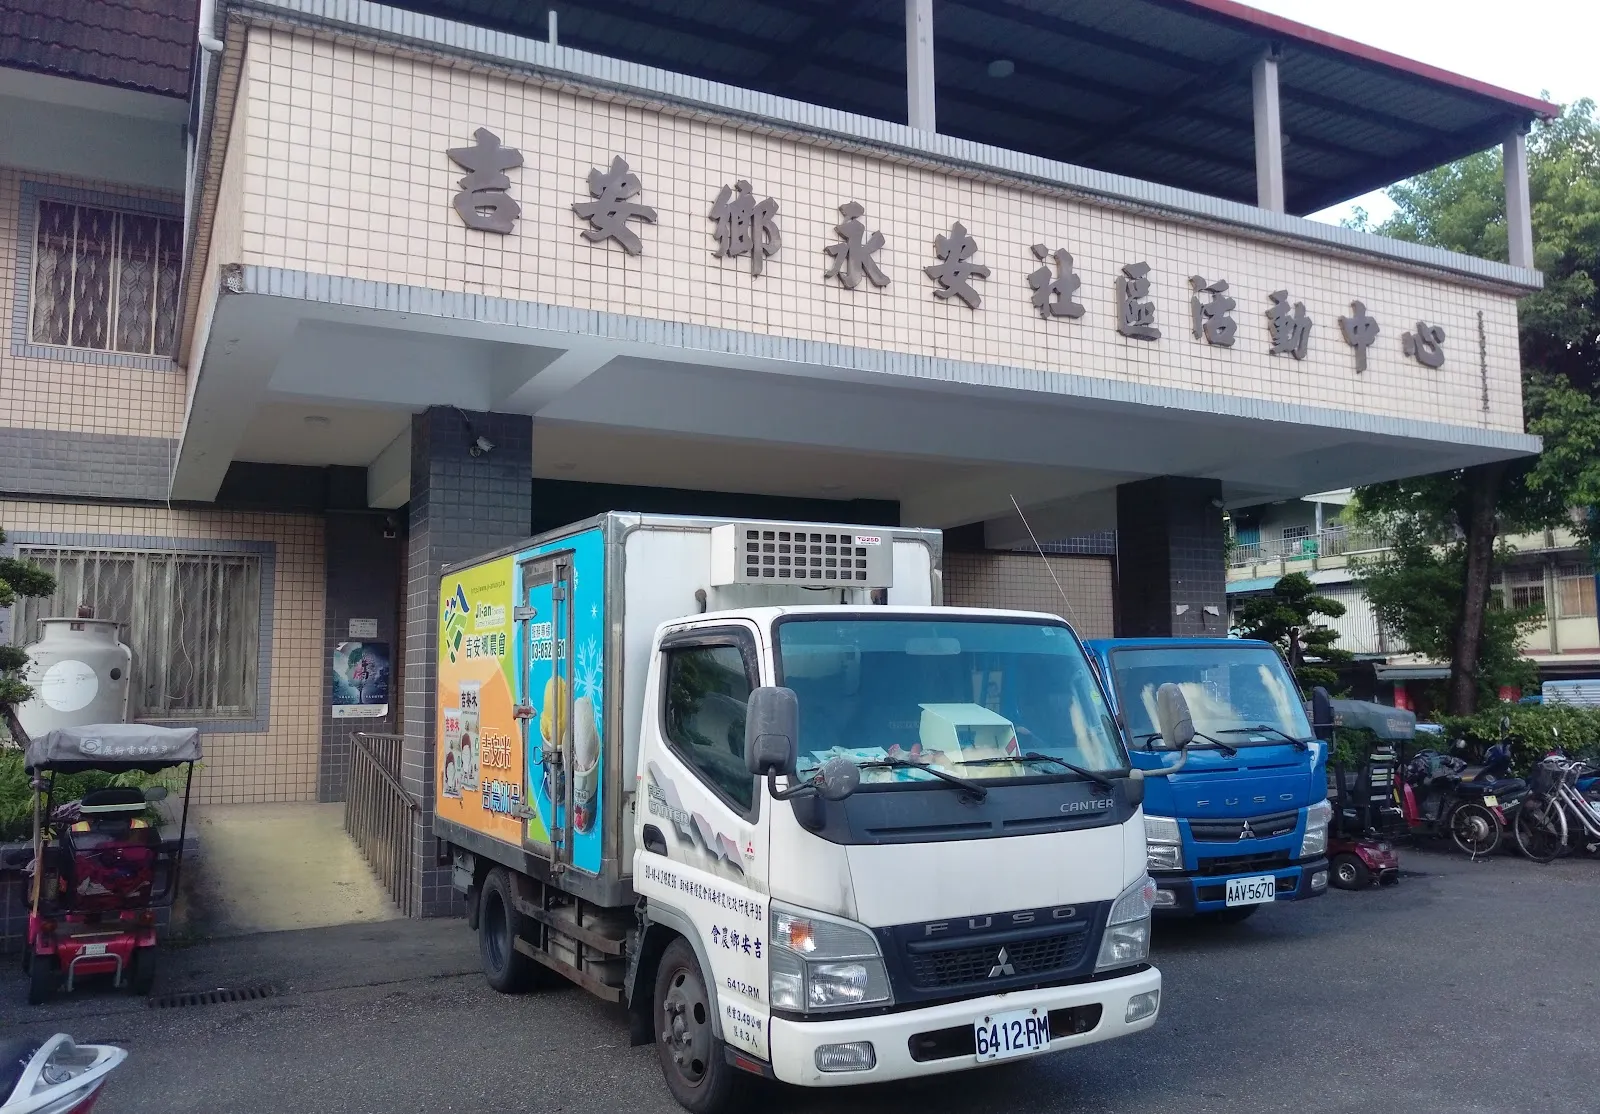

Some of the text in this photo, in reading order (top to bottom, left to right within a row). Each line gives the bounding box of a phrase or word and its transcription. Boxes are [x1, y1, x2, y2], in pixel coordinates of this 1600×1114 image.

[447, 127, 1446, 373] 吉安鄉永安社區活動中心
[466, 632, 506, 659] 吉安鄉農會
[481, 733, 512, 769] 吉安米
[1059, 798, 1115, 814] CANTER
[1196, 793, 1294, 808] FUSO
[1227, 881, 1275, 903] AAV-5670
[925, 906, 1077, 936] FUSO
[727, 977, 760, 1000] 6412-RM
[976, 1015, 1050, 1055] 6412-RM
